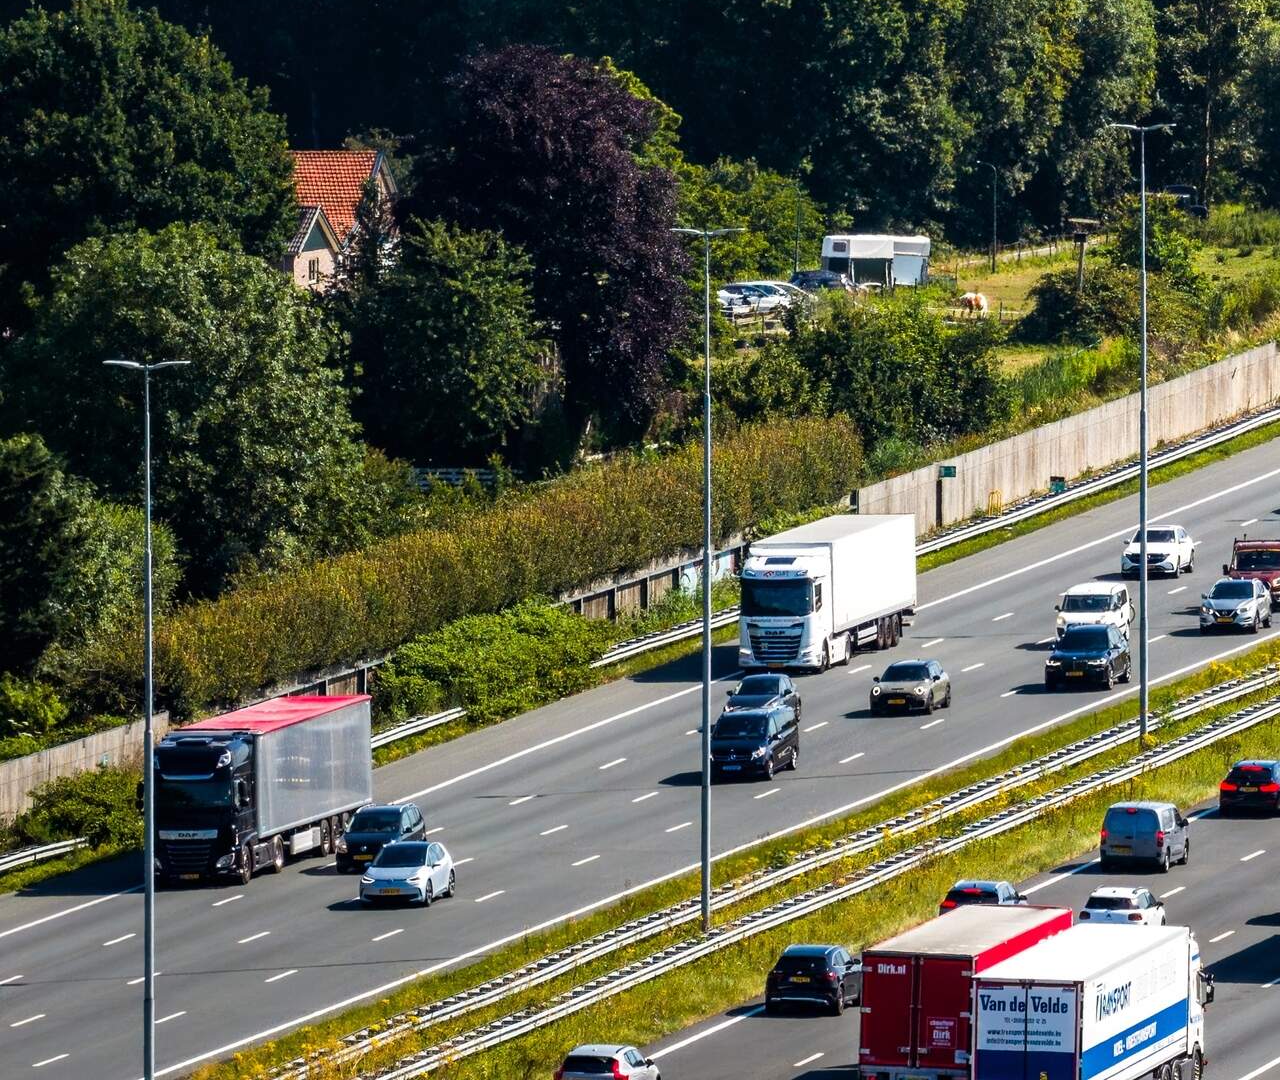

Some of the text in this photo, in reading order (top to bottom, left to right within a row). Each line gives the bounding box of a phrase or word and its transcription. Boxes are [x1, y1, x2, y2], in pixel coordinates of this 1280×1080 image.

[877, 963, 907, 975] Dirk.nl
[980, 994, 1068, 1014] Van de Velde
